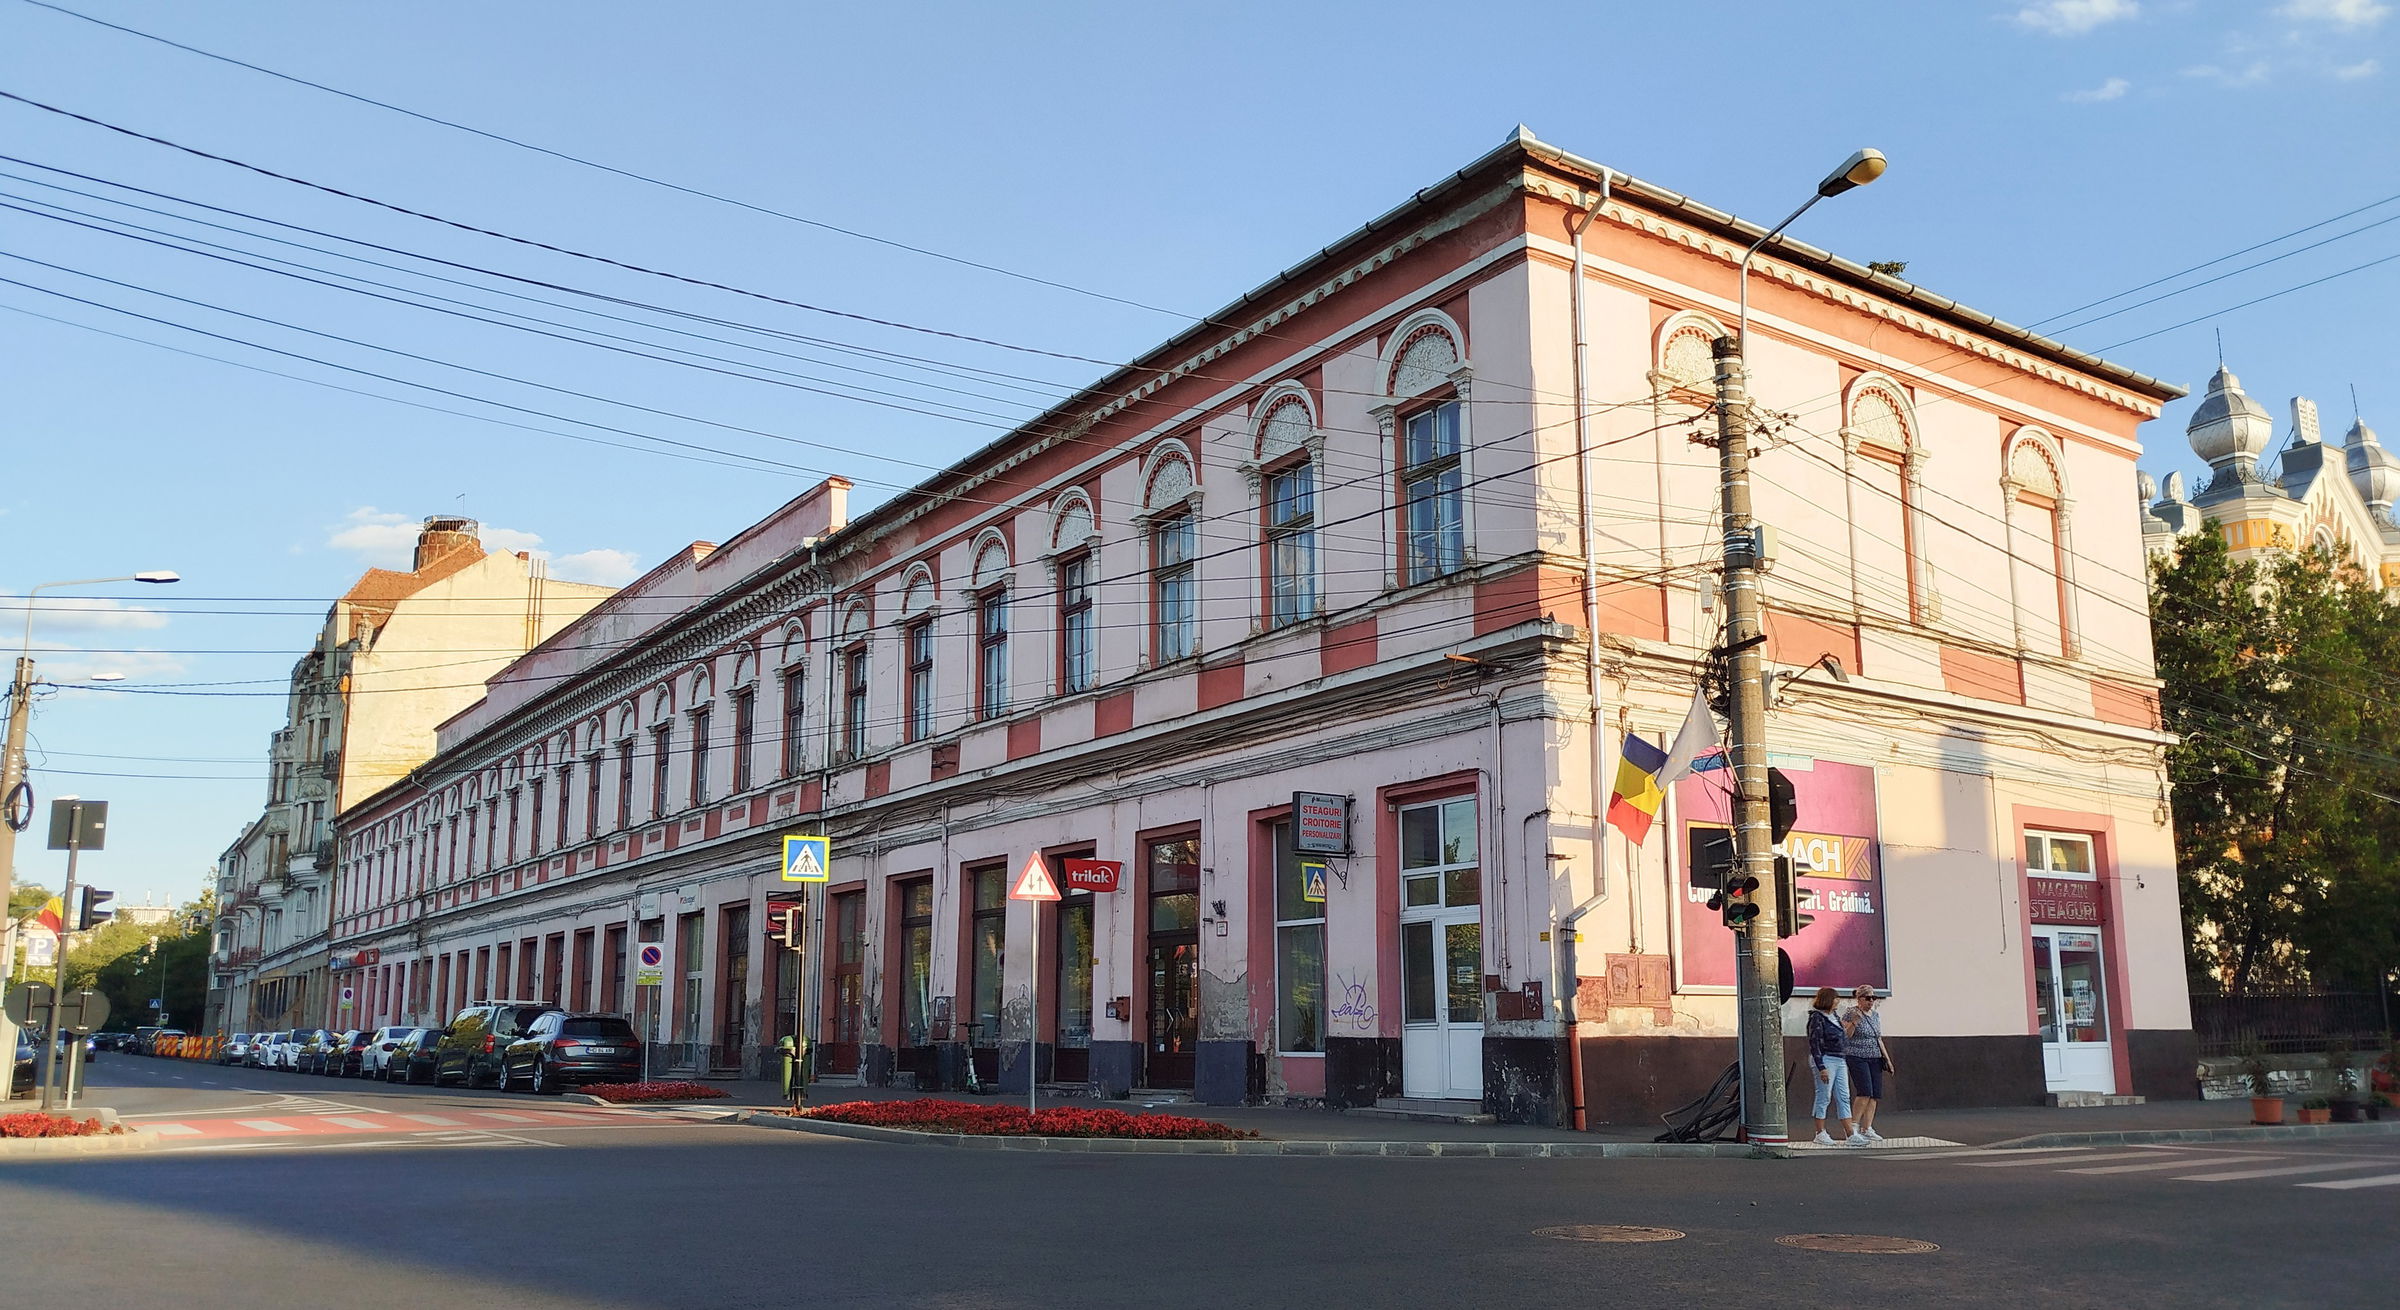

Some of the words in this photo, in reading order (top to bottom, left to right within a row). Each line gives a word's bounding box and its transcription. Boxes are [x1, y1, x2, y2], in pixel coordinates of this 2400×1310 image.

[1303, 805, 1342, 816] STEAGURI
[1303, 817, 1342, 829] CROITORIE
[1072, 869, 1110, 883] trilak
[2037, 881, 2088, 899] MAGAZIN
[1828, 890, 1875, 914] Grădină.
[2030, 900, 2097, 921] STEAGURI
